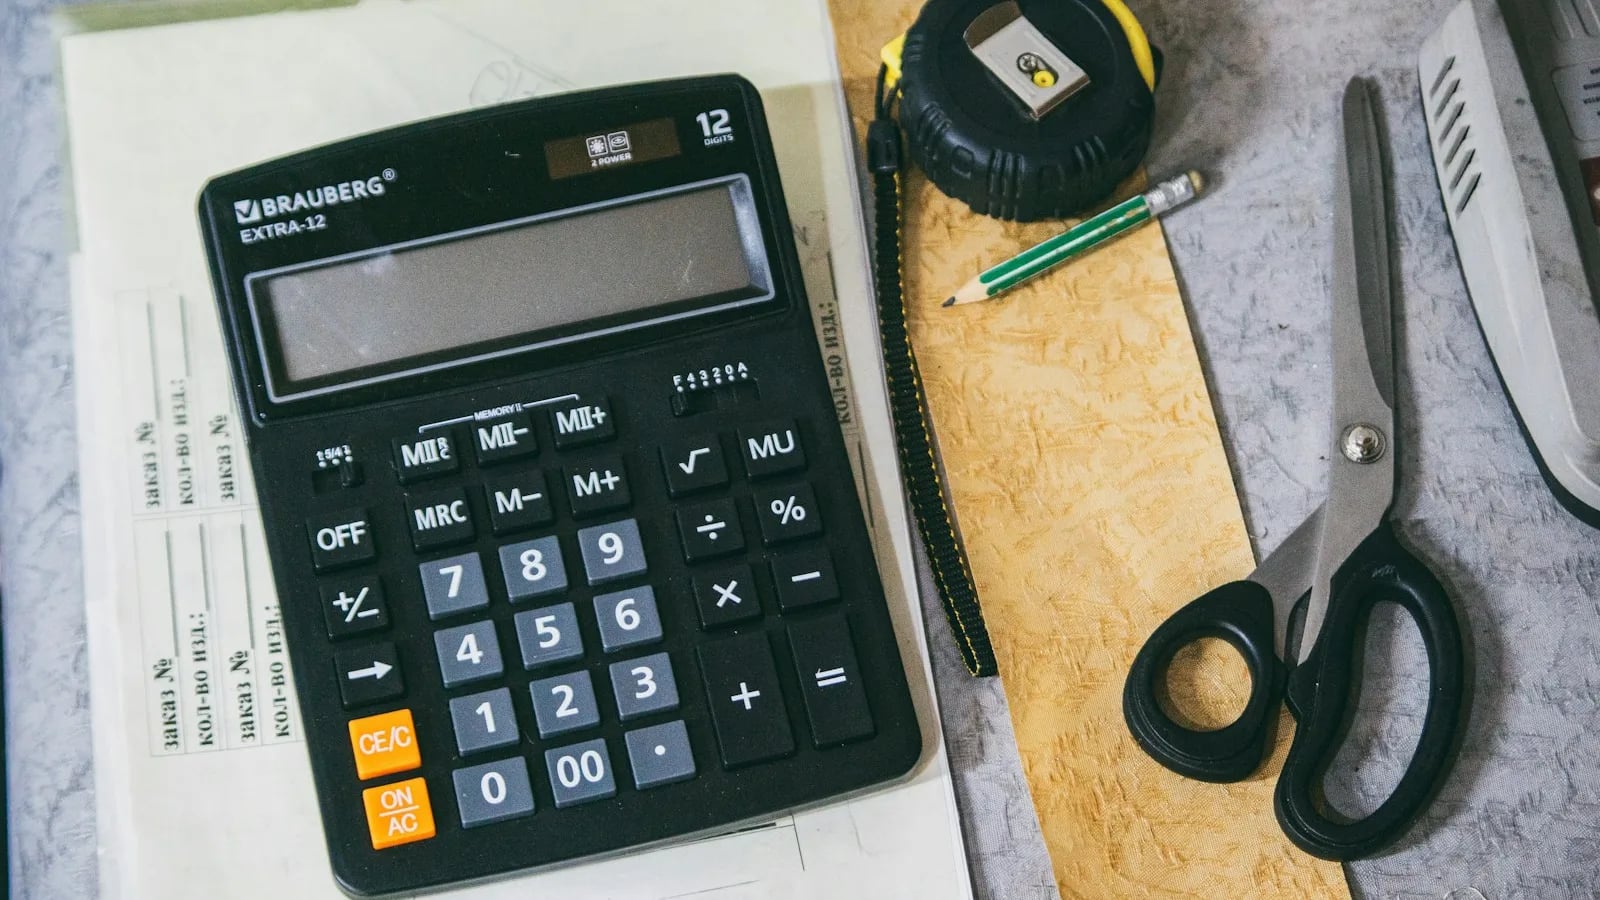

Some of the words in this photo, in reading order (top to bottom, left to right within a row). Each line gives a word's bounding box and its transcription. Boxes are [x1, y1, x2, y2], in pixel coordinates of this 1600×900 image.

[696, 109, 732, 138] 12
[703, 133, 734, 146] DIGITS
[599, 152, 633, 166] POWER
[239, 214, 327, 244] EXTRA-12
[687, 373, 696, 383] 4
[699, 370, 708, 380] 3
[712, 367, 721, 378] 2
[737, 361, 748, 373] A
[473, 404, 516, 421] MEMORY
[748, 430, 795, 460] MU
[573, 470, 620, 497] M+
[414, 500, 467, 531] MRC
[316, 520, 366, 550] OFF
[598, 532, 624, 564] 9
[520, 549, 547, 581] 8
[439, 564, 463, 598] 7
[615, 598, 641, 631] 6
[189, 613, 207, 662] изд.:
[534, 615, 561, 648] 5
[229, 651, 250, 674] №
[456, 633, 484, 664] 4
[153, 658, 174, 682] №
[631, 666, 657, 699] 3
[194, 670, 213, 746] кол-во
[237, 682, 256, 743] заказ
[270, 662, 290, 737] кол-во
[551, 684, 579, 718] 2
[161, 690, 178, 750] заказ
[475, 702, 497, 733] 1
[359, 726, 411, 755] CE/C
[556, 750, 604, 788] 00
[380, 786, 413, 809] ON
[480, 771, 507, 804] 0
[388, 813, 418, 836] AC
